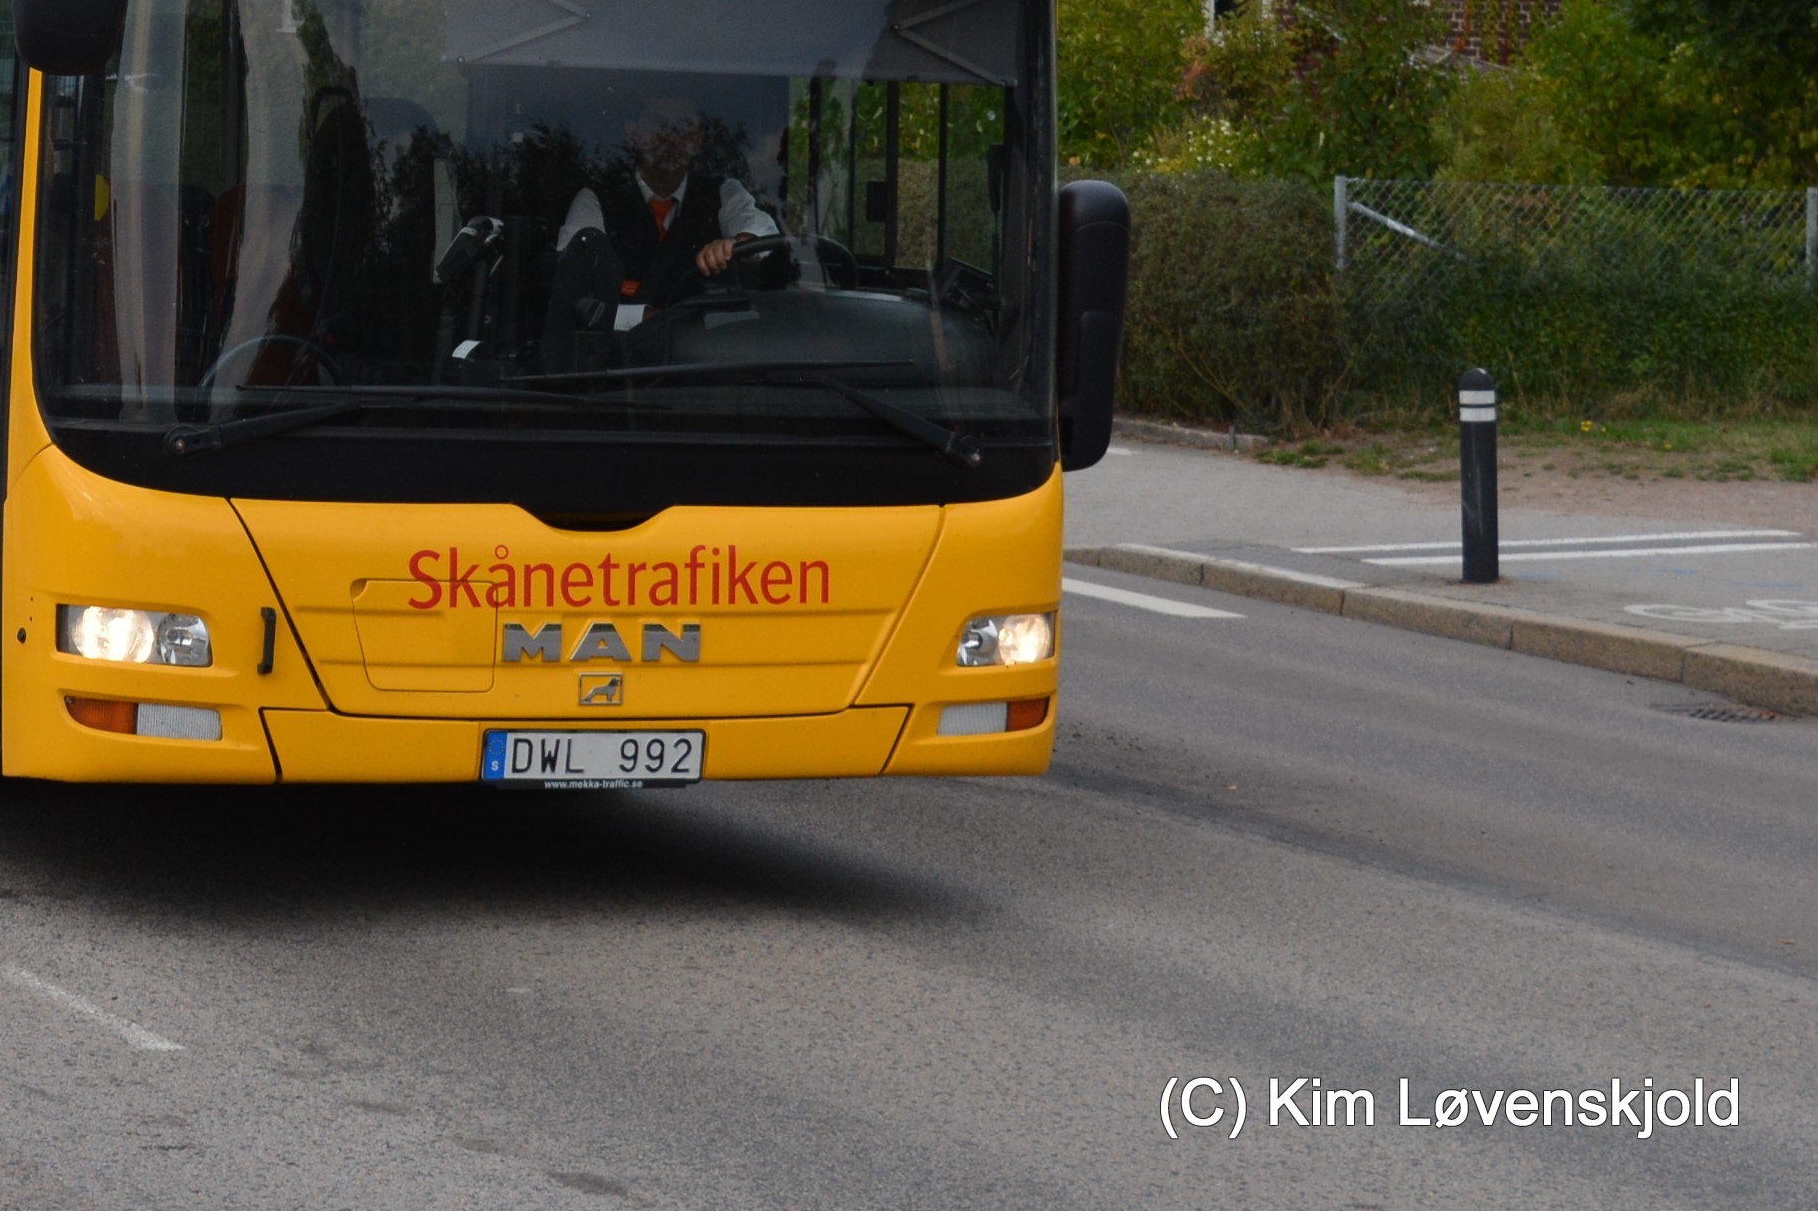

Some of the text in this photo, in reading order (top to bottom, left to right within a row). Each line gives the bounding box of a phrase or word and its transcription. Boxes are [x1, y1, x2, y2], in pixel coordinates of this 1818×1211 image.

[407, 544, 830, 610] Skånetrafiken
[501, 621, 701, 662] MAN
[490, 738, 693, 774] S DWL 992
[544, 778, 644, 789] www.mekka-traffic.se
